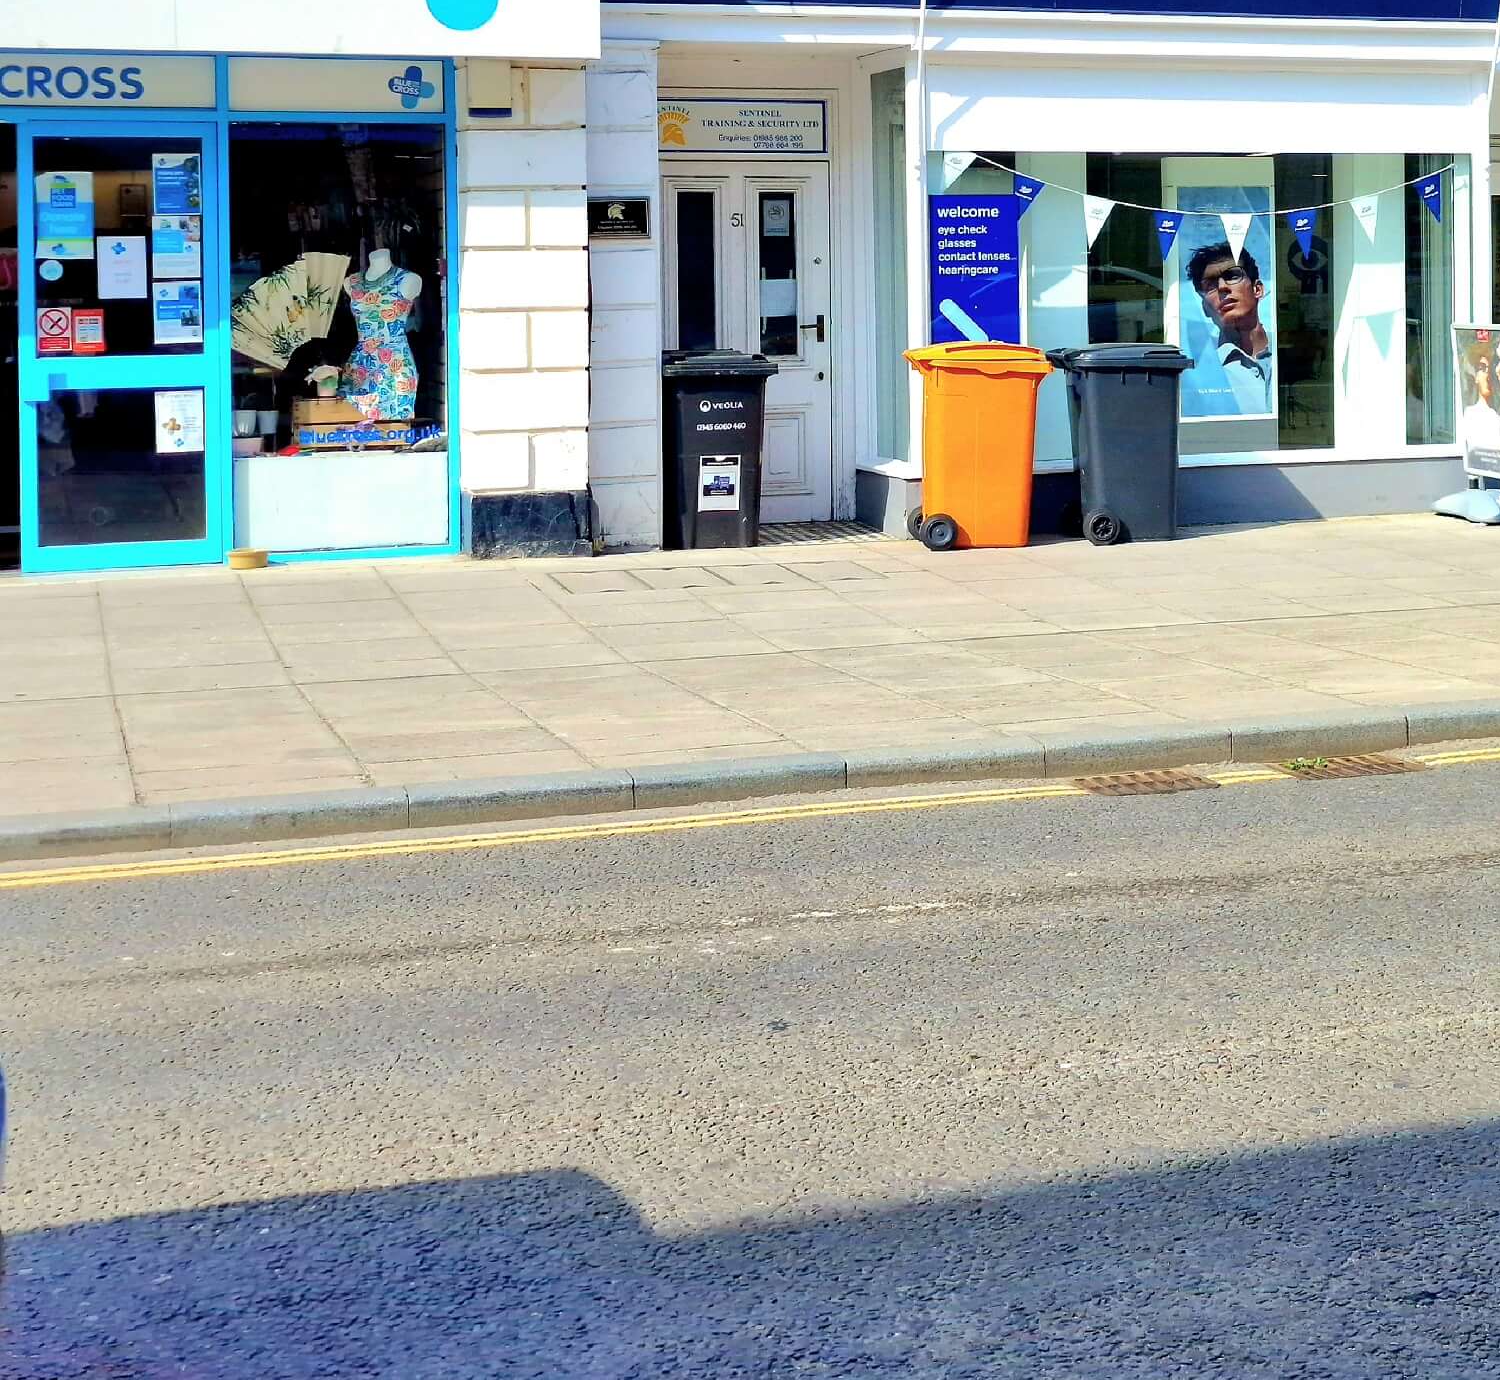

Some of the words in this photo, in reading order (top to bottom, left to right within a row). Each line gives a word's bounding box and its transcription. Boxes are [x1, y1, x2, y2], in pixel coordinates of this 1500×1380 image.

[0, 65, 145, 100] CROSS
[738, 109, 782, 118] SENTINEL
[702, 119, 746, 128] TRAINING
[748, 120, 755, 128] &
[757, 120, 800, 128] SECURITY
[803, 120, 819, 129] LTD
[938, 206, 999, 219] welcome
[731, 212, 744, 228] 51
[938, 226, 956, 236] eye
[957, 224, 988, 235] check
[938, 239, 977, 249] glasses
[938, 251, 976, 262] contact
[979, 251, 1011, 261] lenses
[938, 265, 999, 277] hearingcare
[712, 401, 744, 410] VEOLIA
